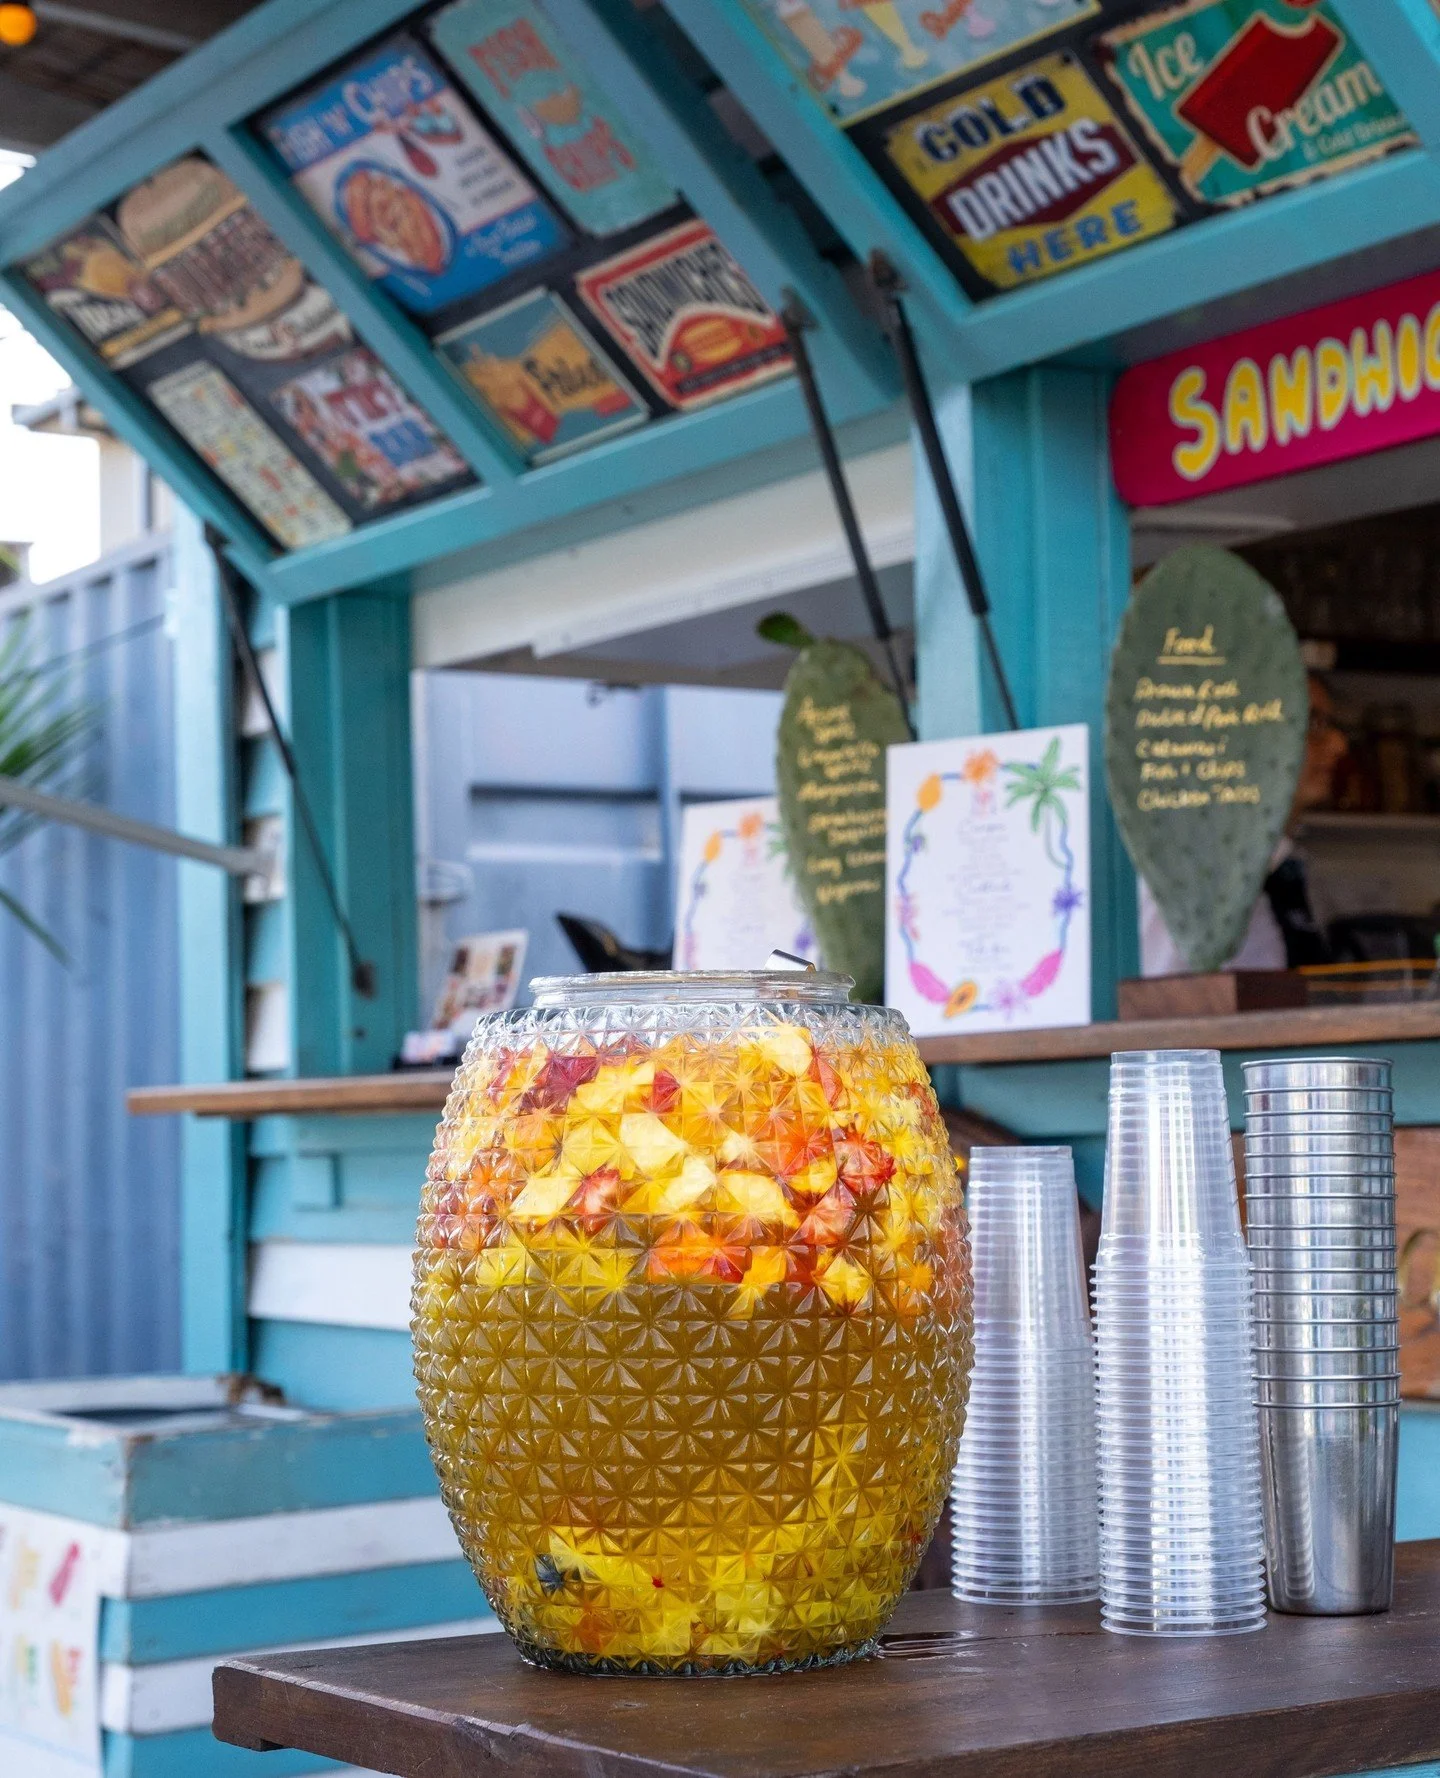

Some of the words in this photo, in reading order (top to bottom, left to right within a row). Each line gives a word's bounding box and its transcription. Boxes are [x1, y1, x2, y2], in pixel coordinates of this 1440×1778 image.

[1128, 32, 1203, 101] Ice
[915, 75, 1067, 162] COLD
[1247, 61, 1384, 161] Cream
[947, 117, 1121, 242] DRINKS
[1007, 198, 1143, 275] HERE
[1163, 624, 1217, 656] Food
